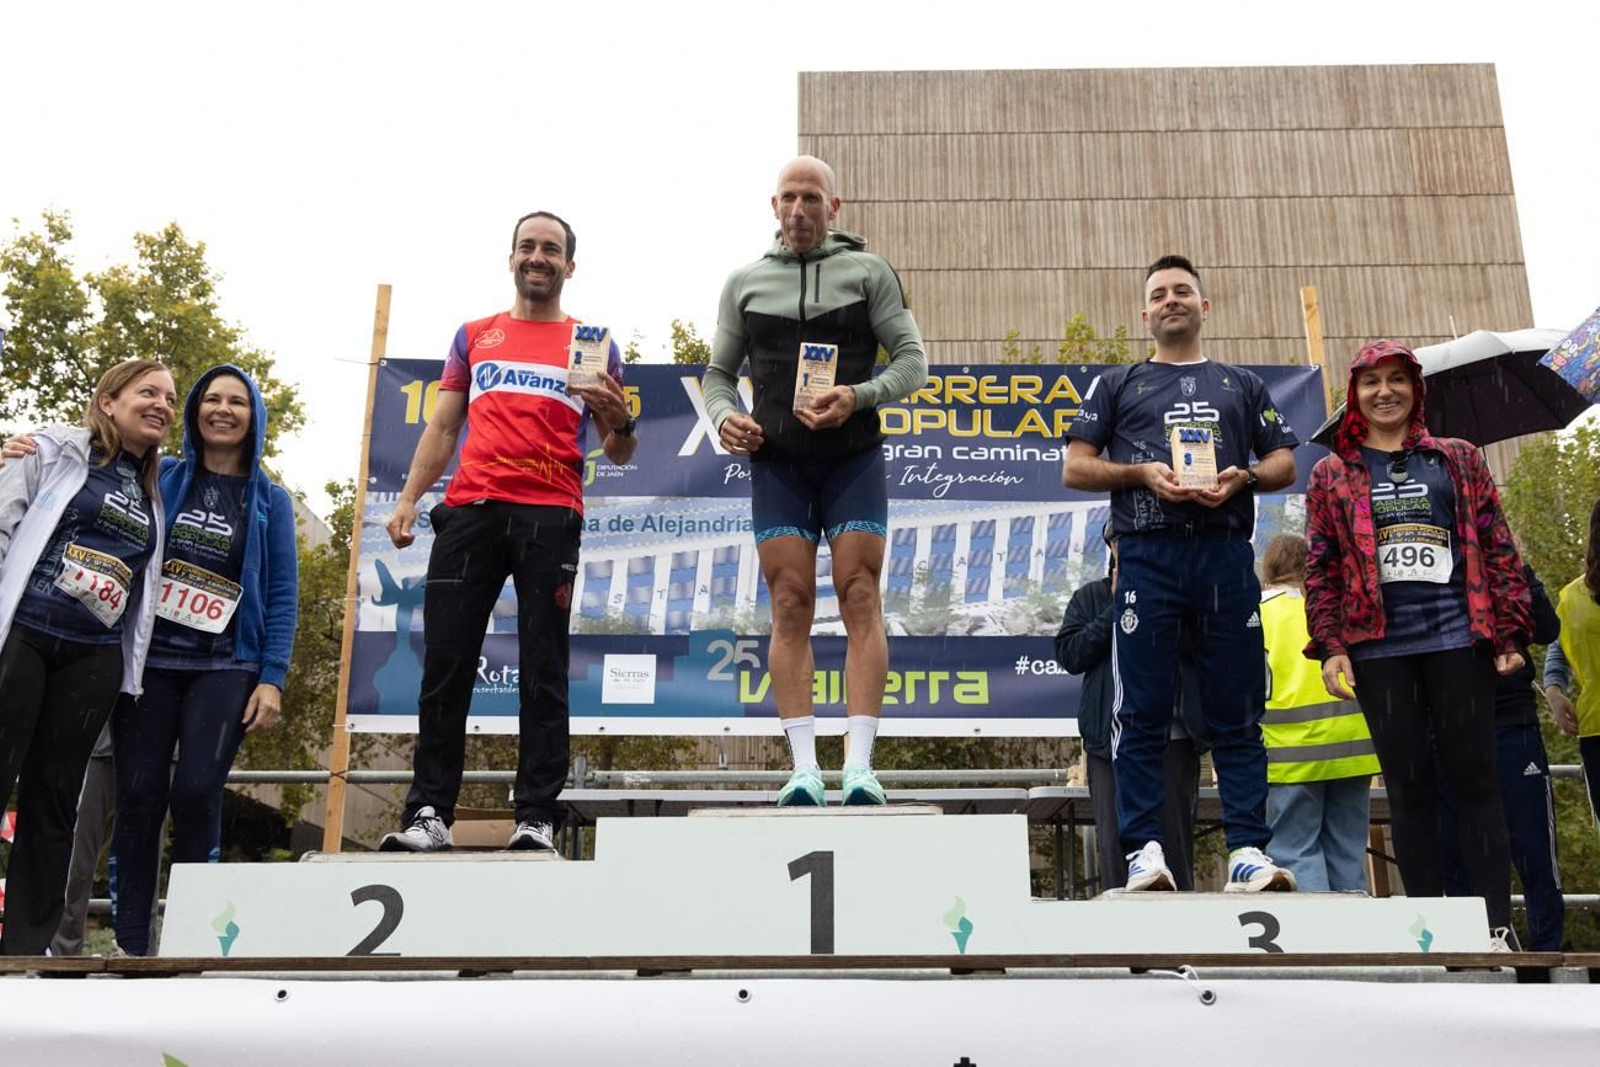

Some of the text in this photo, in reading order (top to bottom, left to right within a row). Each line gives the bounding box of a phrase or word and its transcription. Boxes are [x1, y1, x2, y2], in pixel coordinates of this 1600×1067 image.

[575, 326, 608, 342] XXV
[803, 345, 835, 362] XXV
[503, 369, 571, 398] Avanz
[898, 375, 1083, 404] RRERA
[1164, 401, 1220, 424] 25
[1179, 429, 1211, 443] XXV
[898, 462, 1024, 498] Integración
[1374, 496, 1429, 506] ARRERA
[175, 509, 233, 536] 25
[608, 514, 635, 532] de
[640, 514, 754, 537] Alejandría
[66, 547, 87, 561] XXV
[1383, 546, 1435, 568] 496
[160, 582, 225, 620] 1106
[1124, 590, 1137, 604] 16
[706, 640, 760, 681] 25
[610, 667, 650, 678] Sierras
[787, 850, 834, 955] 1
[345, 884, 404, 956] 2
[1238, 911, 1284, 953] 3
